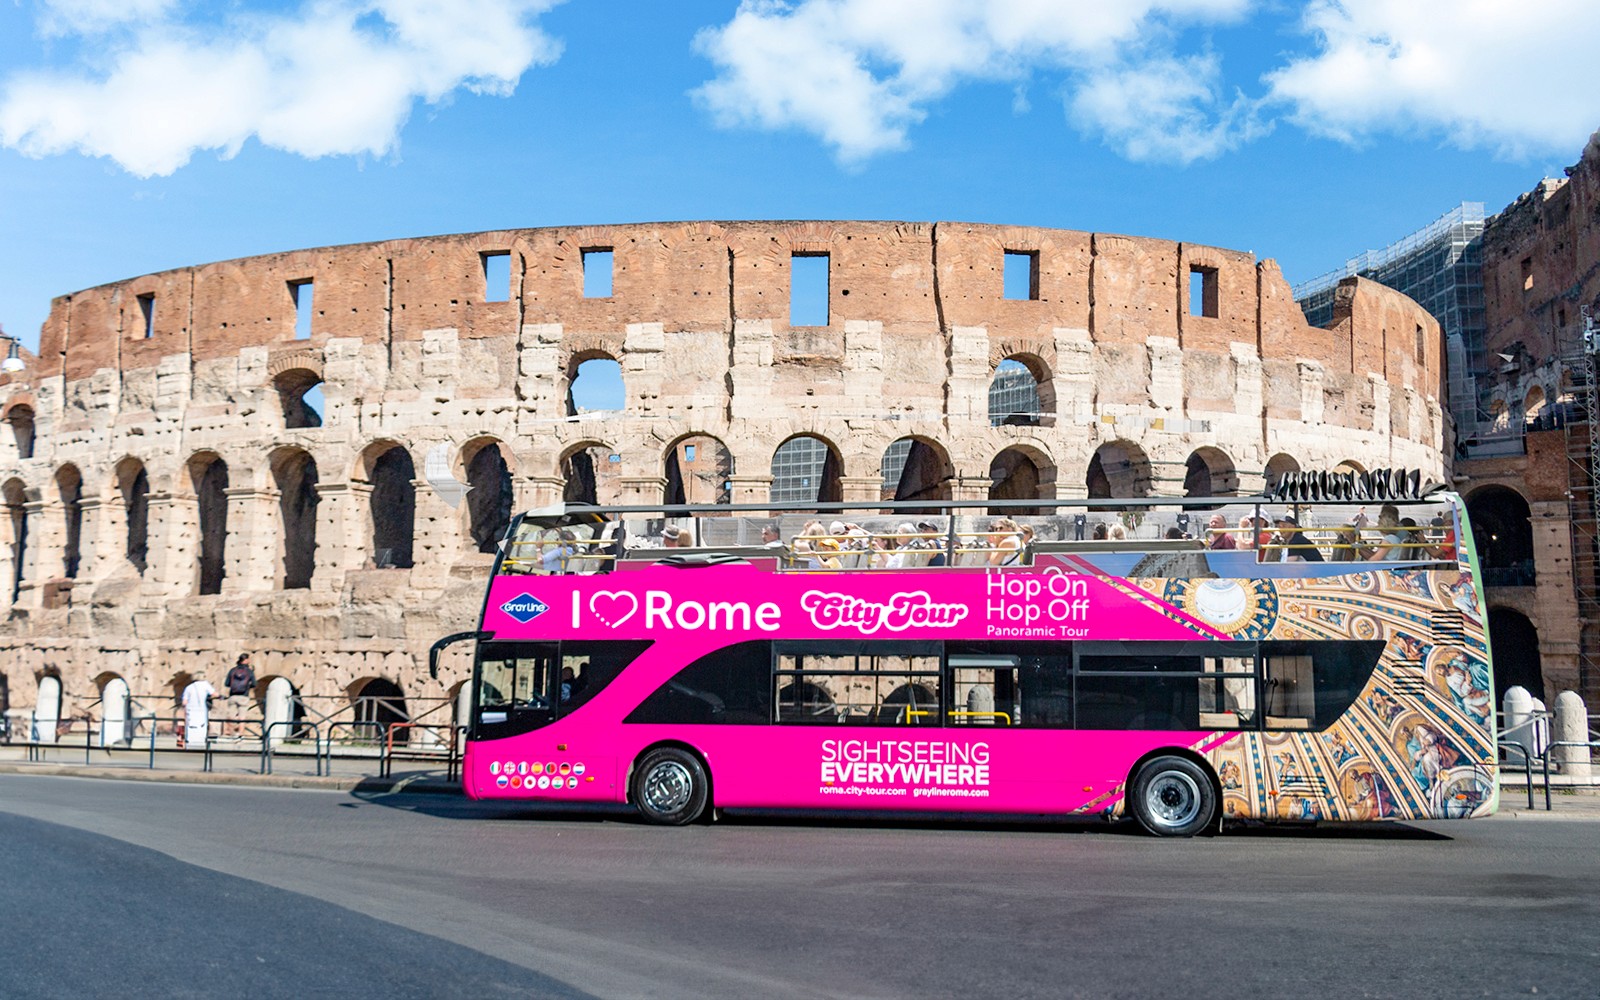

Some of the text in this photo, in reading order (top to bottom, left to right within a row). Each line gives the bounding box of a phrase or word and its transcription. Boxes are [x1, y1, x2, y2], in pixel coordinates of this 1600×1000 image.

[572, 590, 781, 631] I Rome
[801, 590, 969, 634] City Tour
[987, 625, 1090, 637] Panoramic Tour
[821, 740, 990, 764] SIGHTSEEING
[820, 762, 990, 785] EVERYWHERE
[819, 786, 990, 798] roma.city-tour.com graylinerome.com
